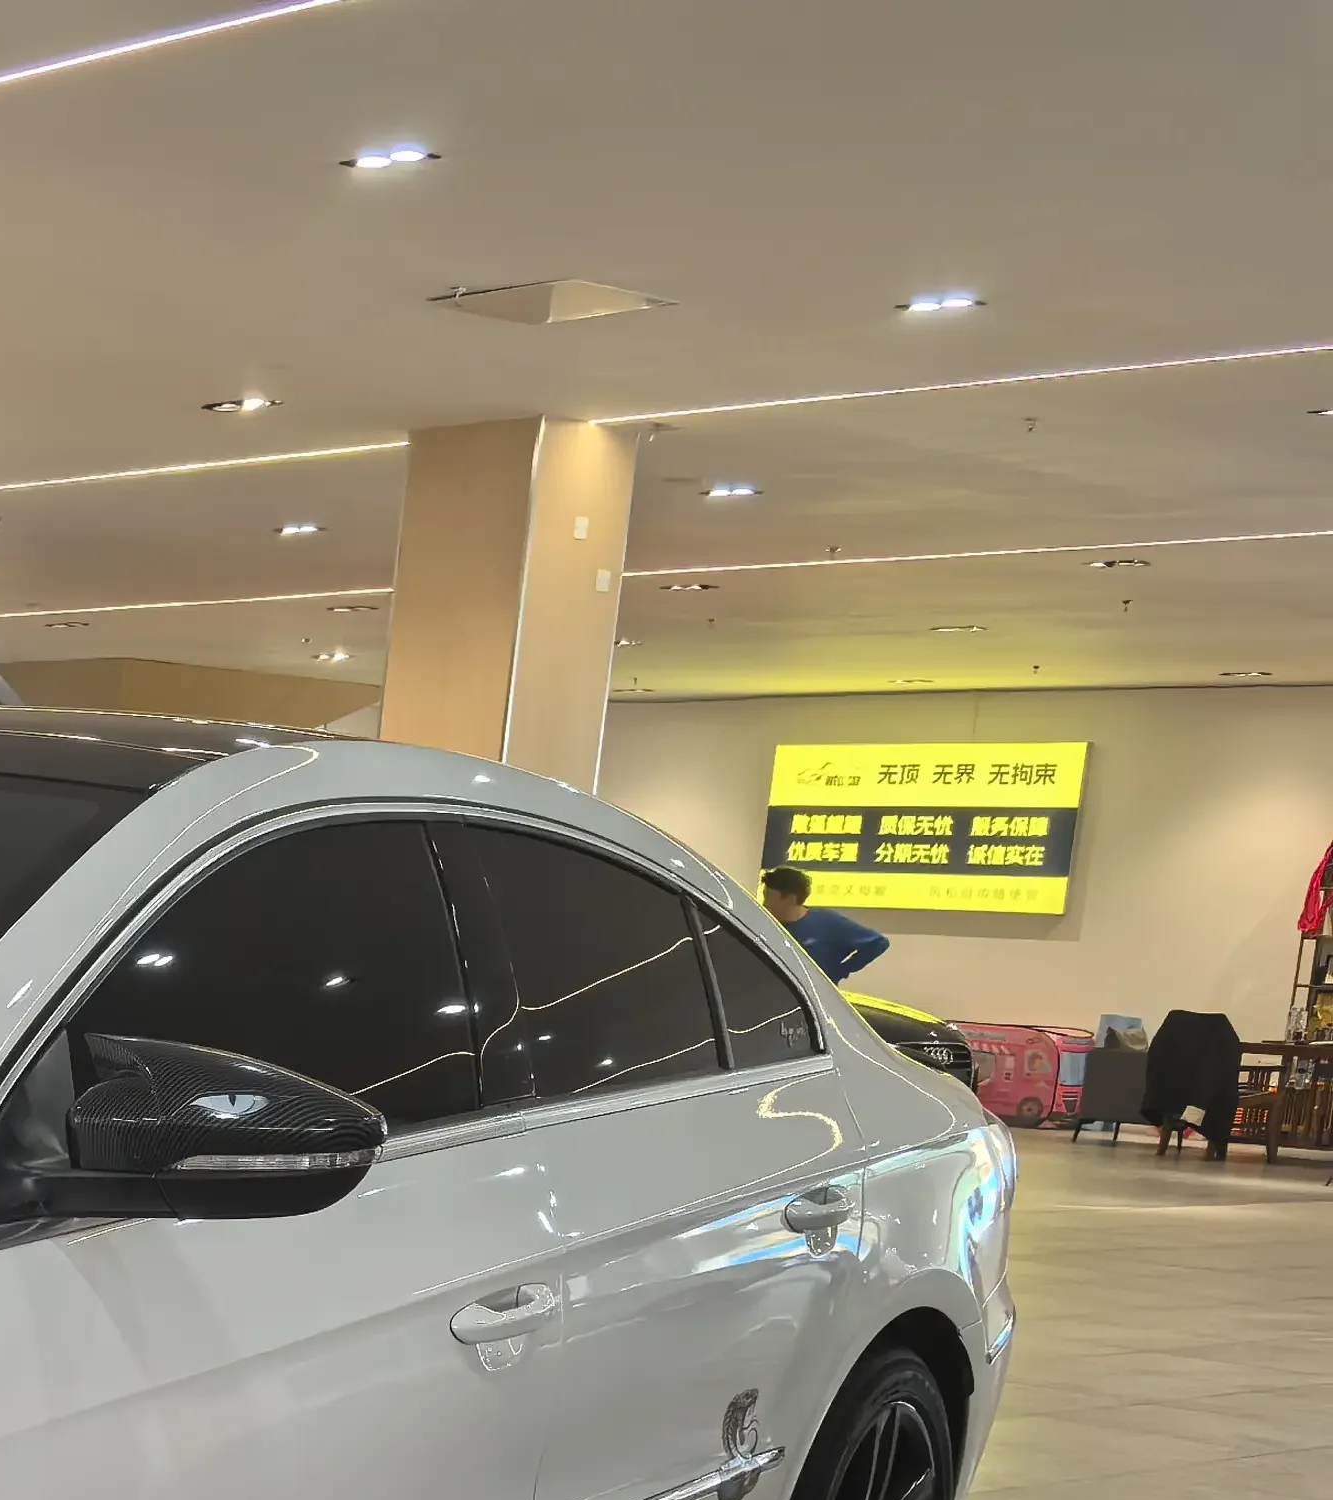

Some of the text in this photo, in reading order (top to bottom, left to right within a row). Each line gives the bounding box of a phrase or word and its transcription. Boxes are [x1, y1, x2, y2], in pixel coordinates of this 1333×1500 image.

[877, 763, 921, 785] 无顶
[932, 763, 976, 785] 无界
[987, 762, 1058, 786] 无拘束
